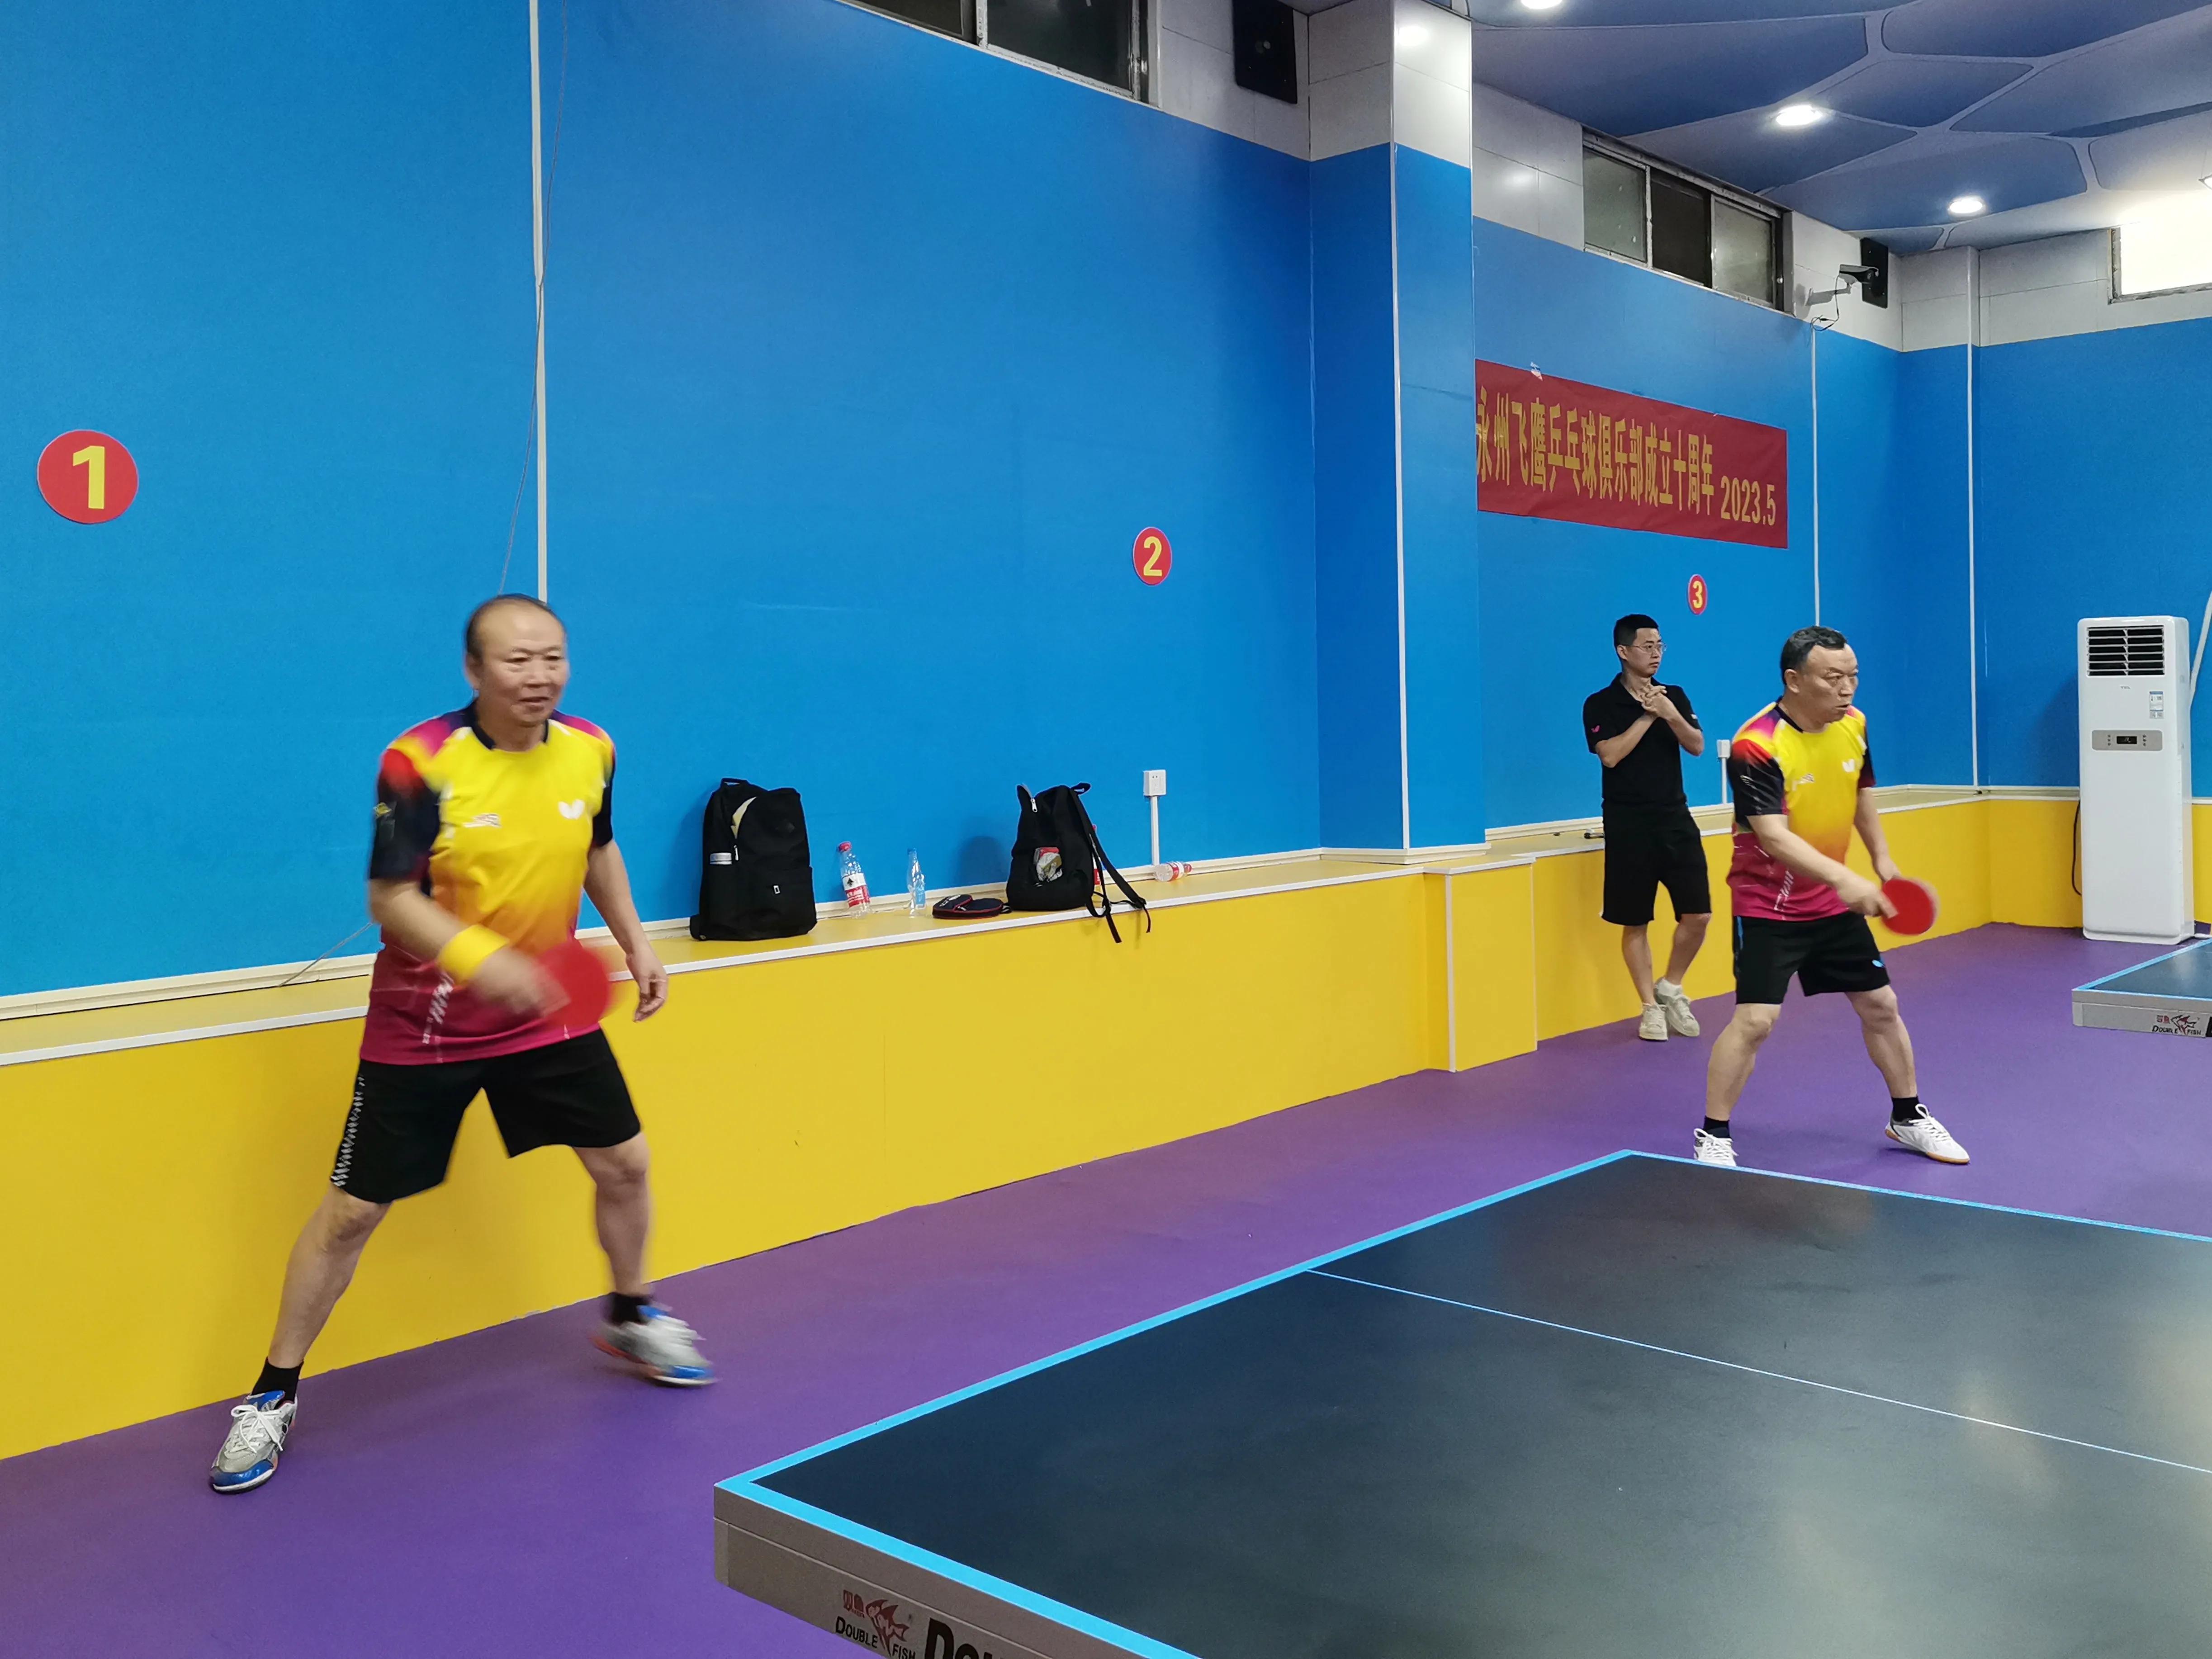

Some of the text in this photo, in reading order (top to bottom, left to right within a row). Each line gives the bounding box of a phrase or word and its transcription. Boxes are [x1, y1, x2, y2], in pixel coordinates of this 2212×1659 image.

[1476, 385, 1776, 526] 永州飞鹰乒乓球俱乐部成立十周年 2023.5
[72, 445, 105, 510] 1
[1143, 536, 1162, 577] 2
[1692, 580, 1703, 609] 3
[835, 1616, 878, 1649] DOUBLE
